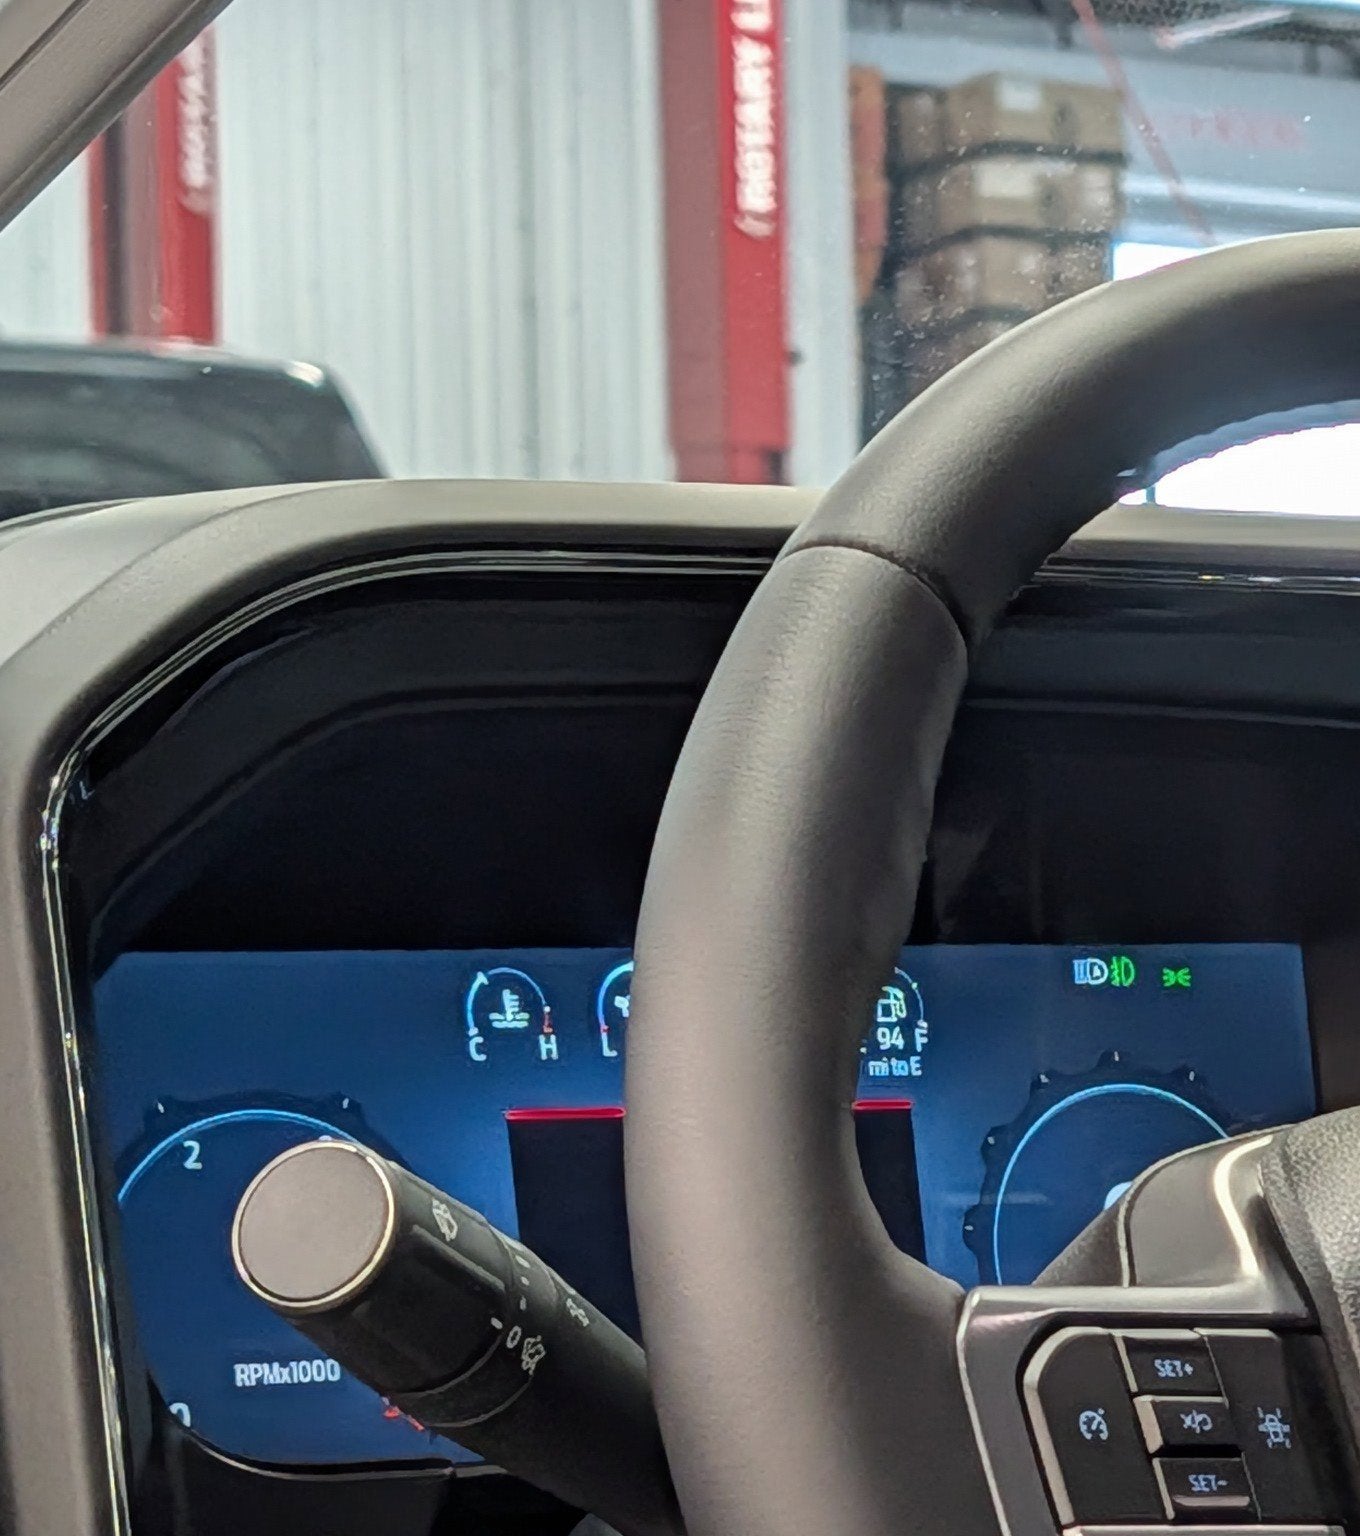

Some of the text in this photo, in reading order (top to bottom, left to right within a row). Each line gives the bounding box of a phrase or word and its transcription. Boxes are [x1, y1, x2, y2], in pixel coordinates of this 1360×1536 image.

[469, 1036, 487, 1062] C
[539, 1034, 559, 1060] H
[876, 1026, 905, 1050] 94
[914, 1028, 928, 1052] F
[183, 1139, 203, 1172] 2
[233, 1359, 341, 1388] RPMx1000
